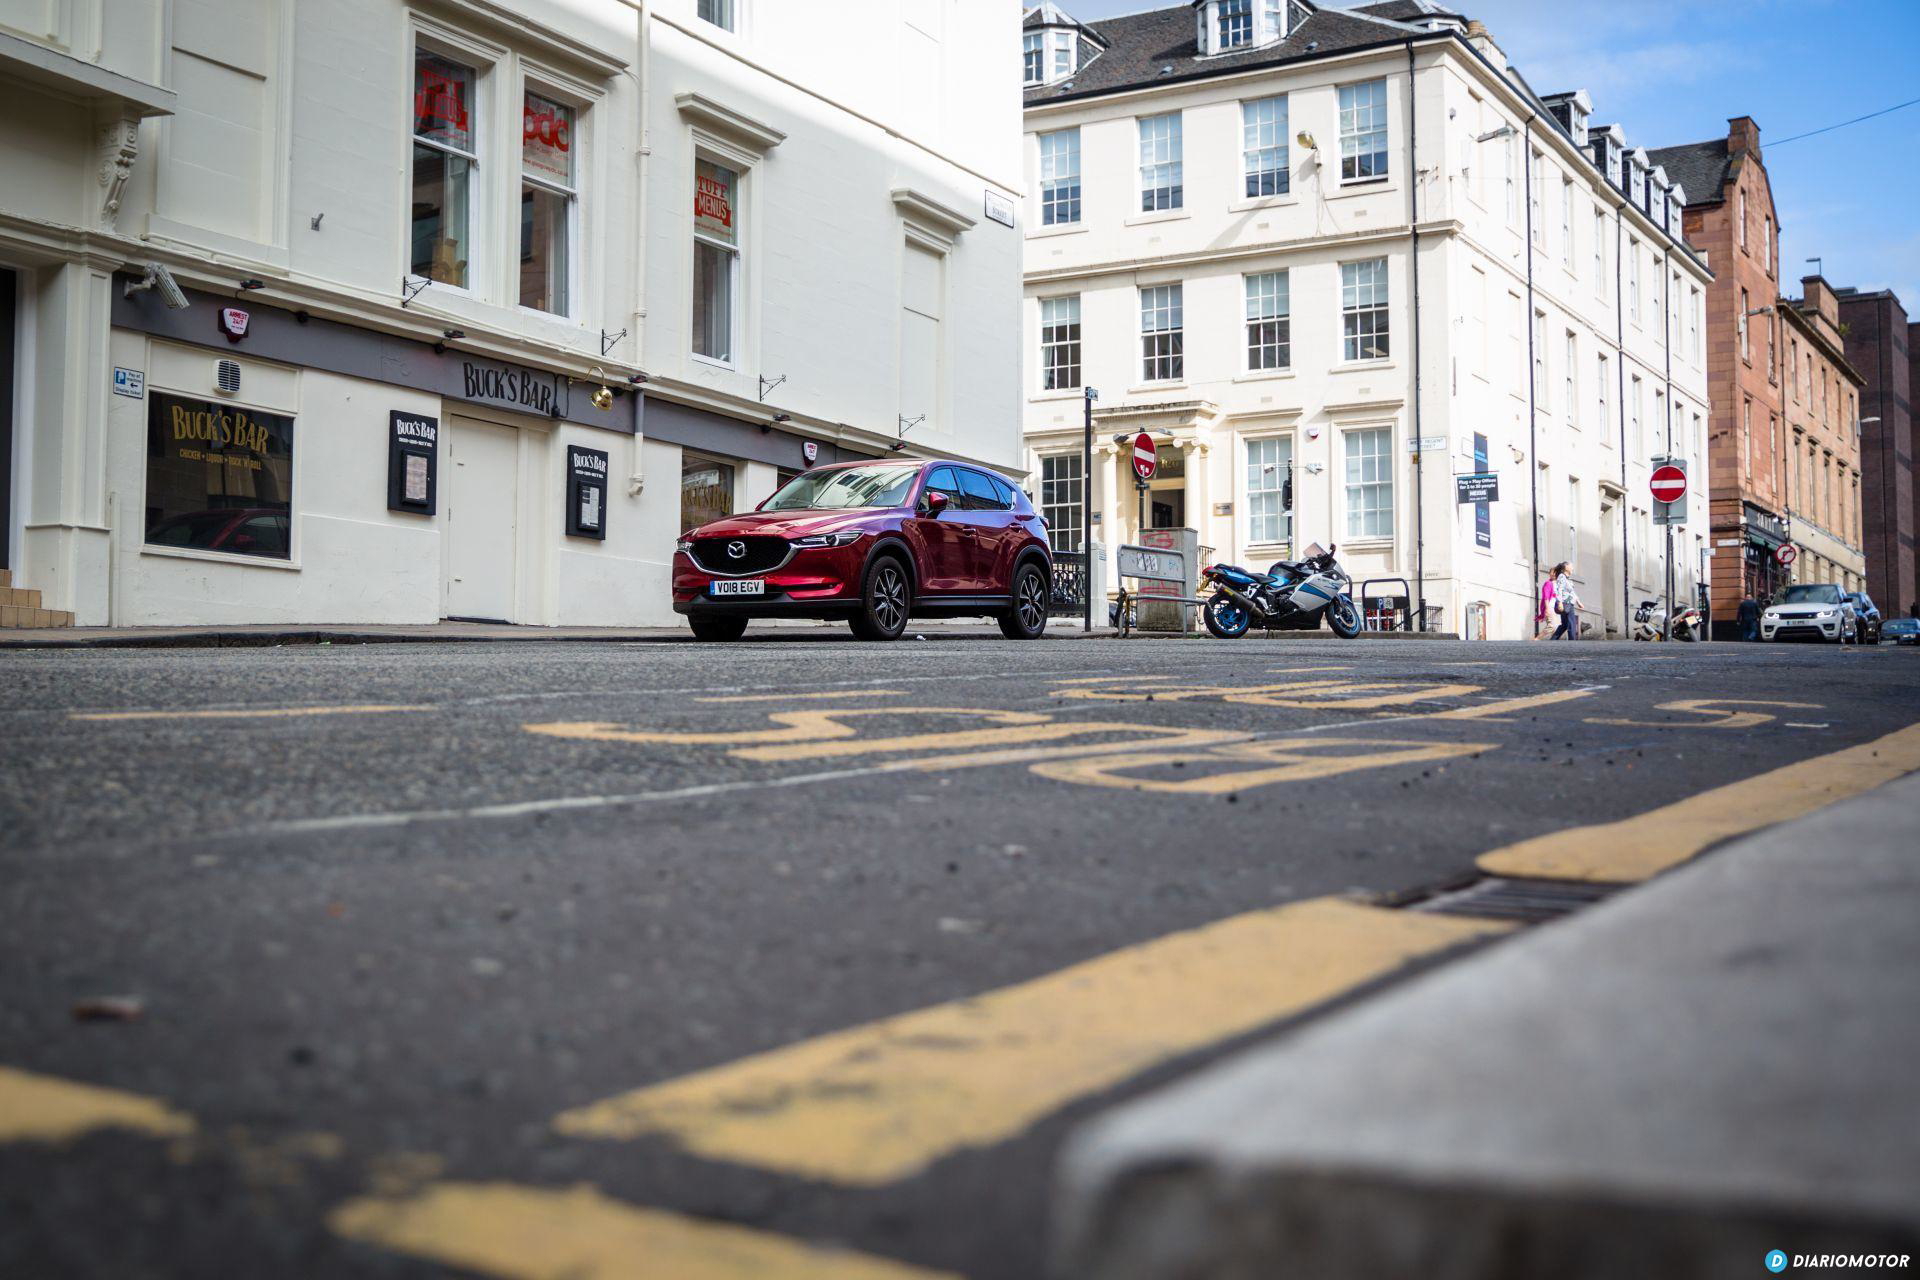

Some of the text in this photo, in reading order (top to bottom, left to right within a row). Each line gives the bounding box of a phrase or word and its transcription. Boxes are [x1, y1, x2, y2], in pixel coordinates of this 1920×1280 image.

[698, 193, 727, 220] MENUS
[463, 362, 552, 414] BUCK'S BAR
[171, 405, 270, 455] BUCK'S BAR
[396, 419, 436, 441] BUCK'S BAR
[573, 453, 607, 473] BUCK'S BAR
[740, 581, 760, 592] EGV
